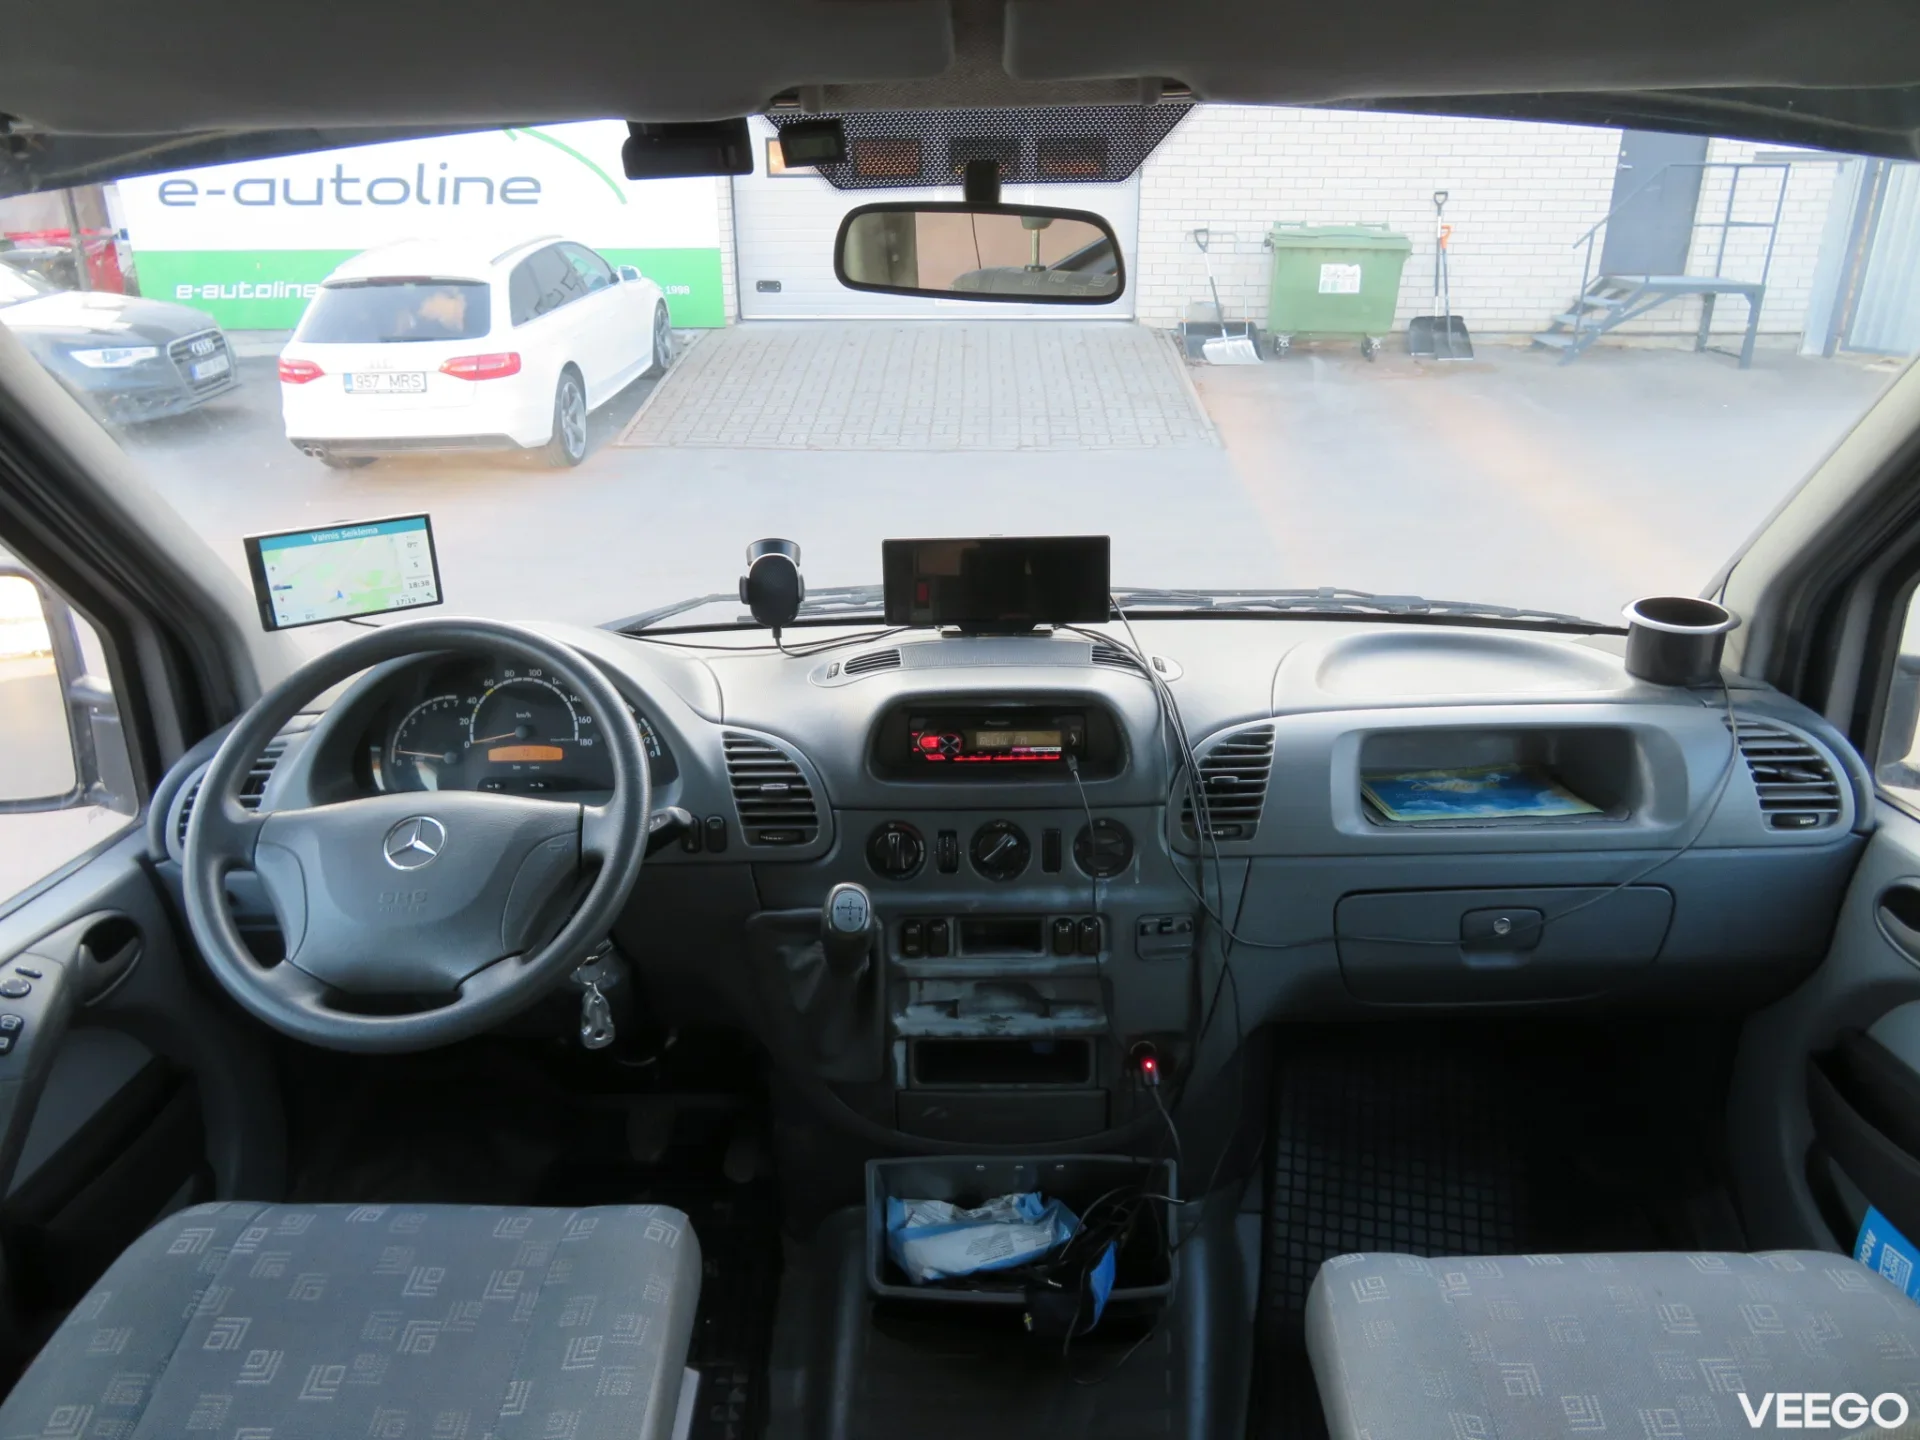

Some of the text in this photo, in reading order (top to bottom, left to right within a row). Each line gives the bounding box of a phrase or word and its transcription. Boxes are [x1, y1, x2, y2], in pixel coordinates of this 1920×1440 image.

[158, 162, 542, 207] e-autoline
[175, 281, 320, 300] e-autoline
[356, 373, 422, 389] 957 MRS
[504, 669, 515, 678] 80
[528, 668, 543, 677] 100
[483, 678, 495, 687] 60
[466, 697, 478, 705] 40
[459, 717, 470, 726] 20
[578, 715, 592, 725] 160
[579, 738, 593, 747] 180
